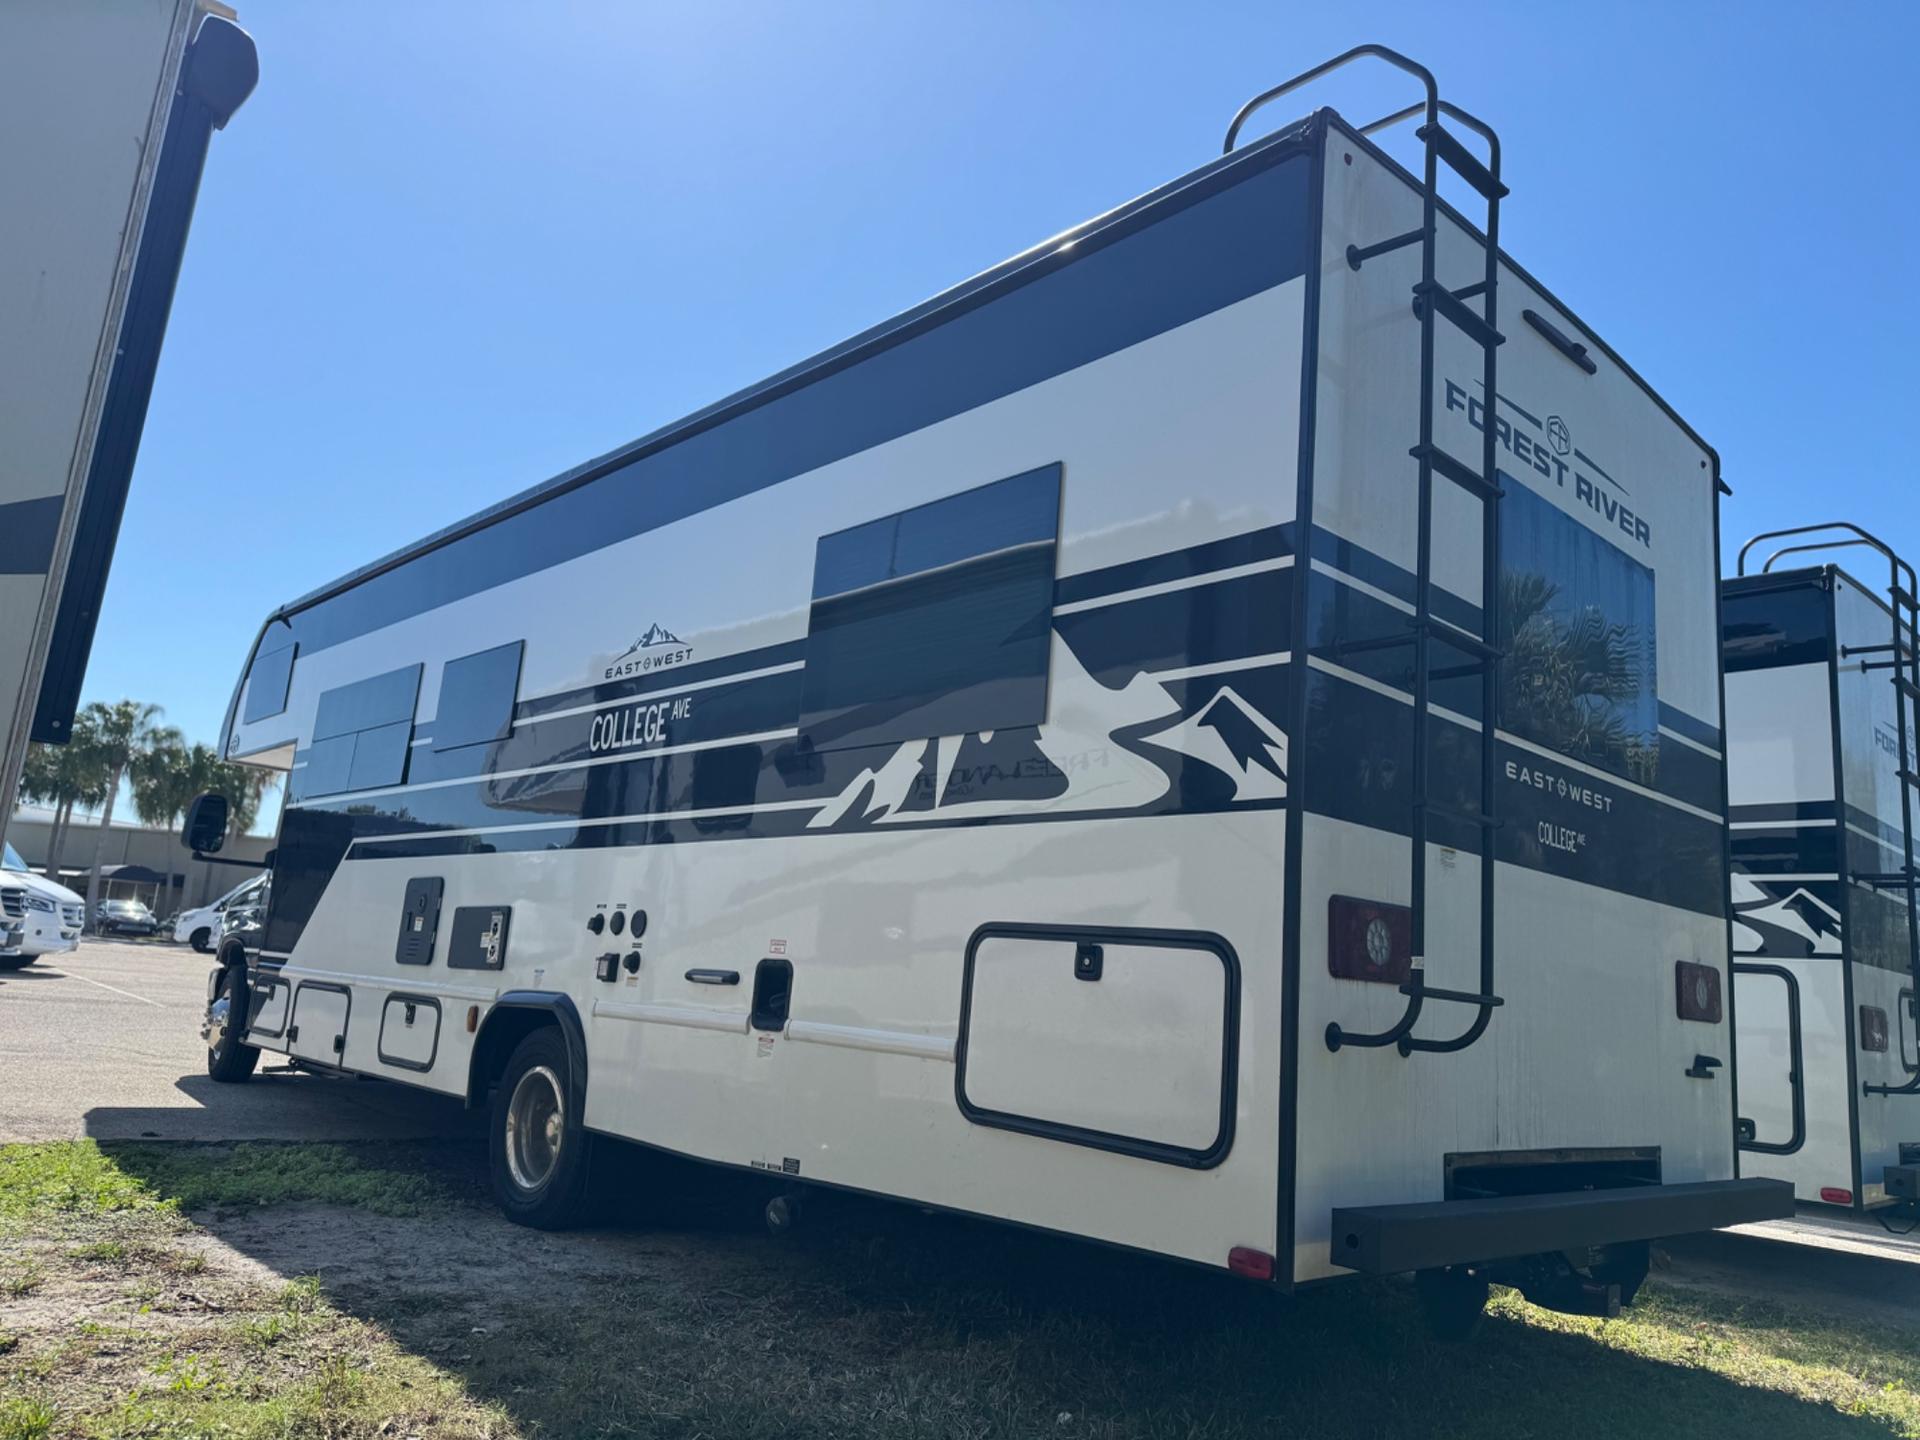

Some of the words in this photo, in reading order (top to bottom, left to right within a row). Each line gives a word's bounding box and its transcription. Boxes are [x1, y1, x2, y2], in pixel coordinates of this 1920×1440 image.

[1445, 378, 1569, 488] FOREST
[1575, 472, 1650, 548] RIVER
[604, 660, 642, 679] EAST
[653, 648, 693, 668] WEST
[589, 701, 670, 752] COLLEGE
[671, 697, 692, 721] AVE
[1505, 761, 1554, 792] EAST
[1569, 783, 1612, 813] WEST
[1538, 821, 1577, 853] COLLEGE
